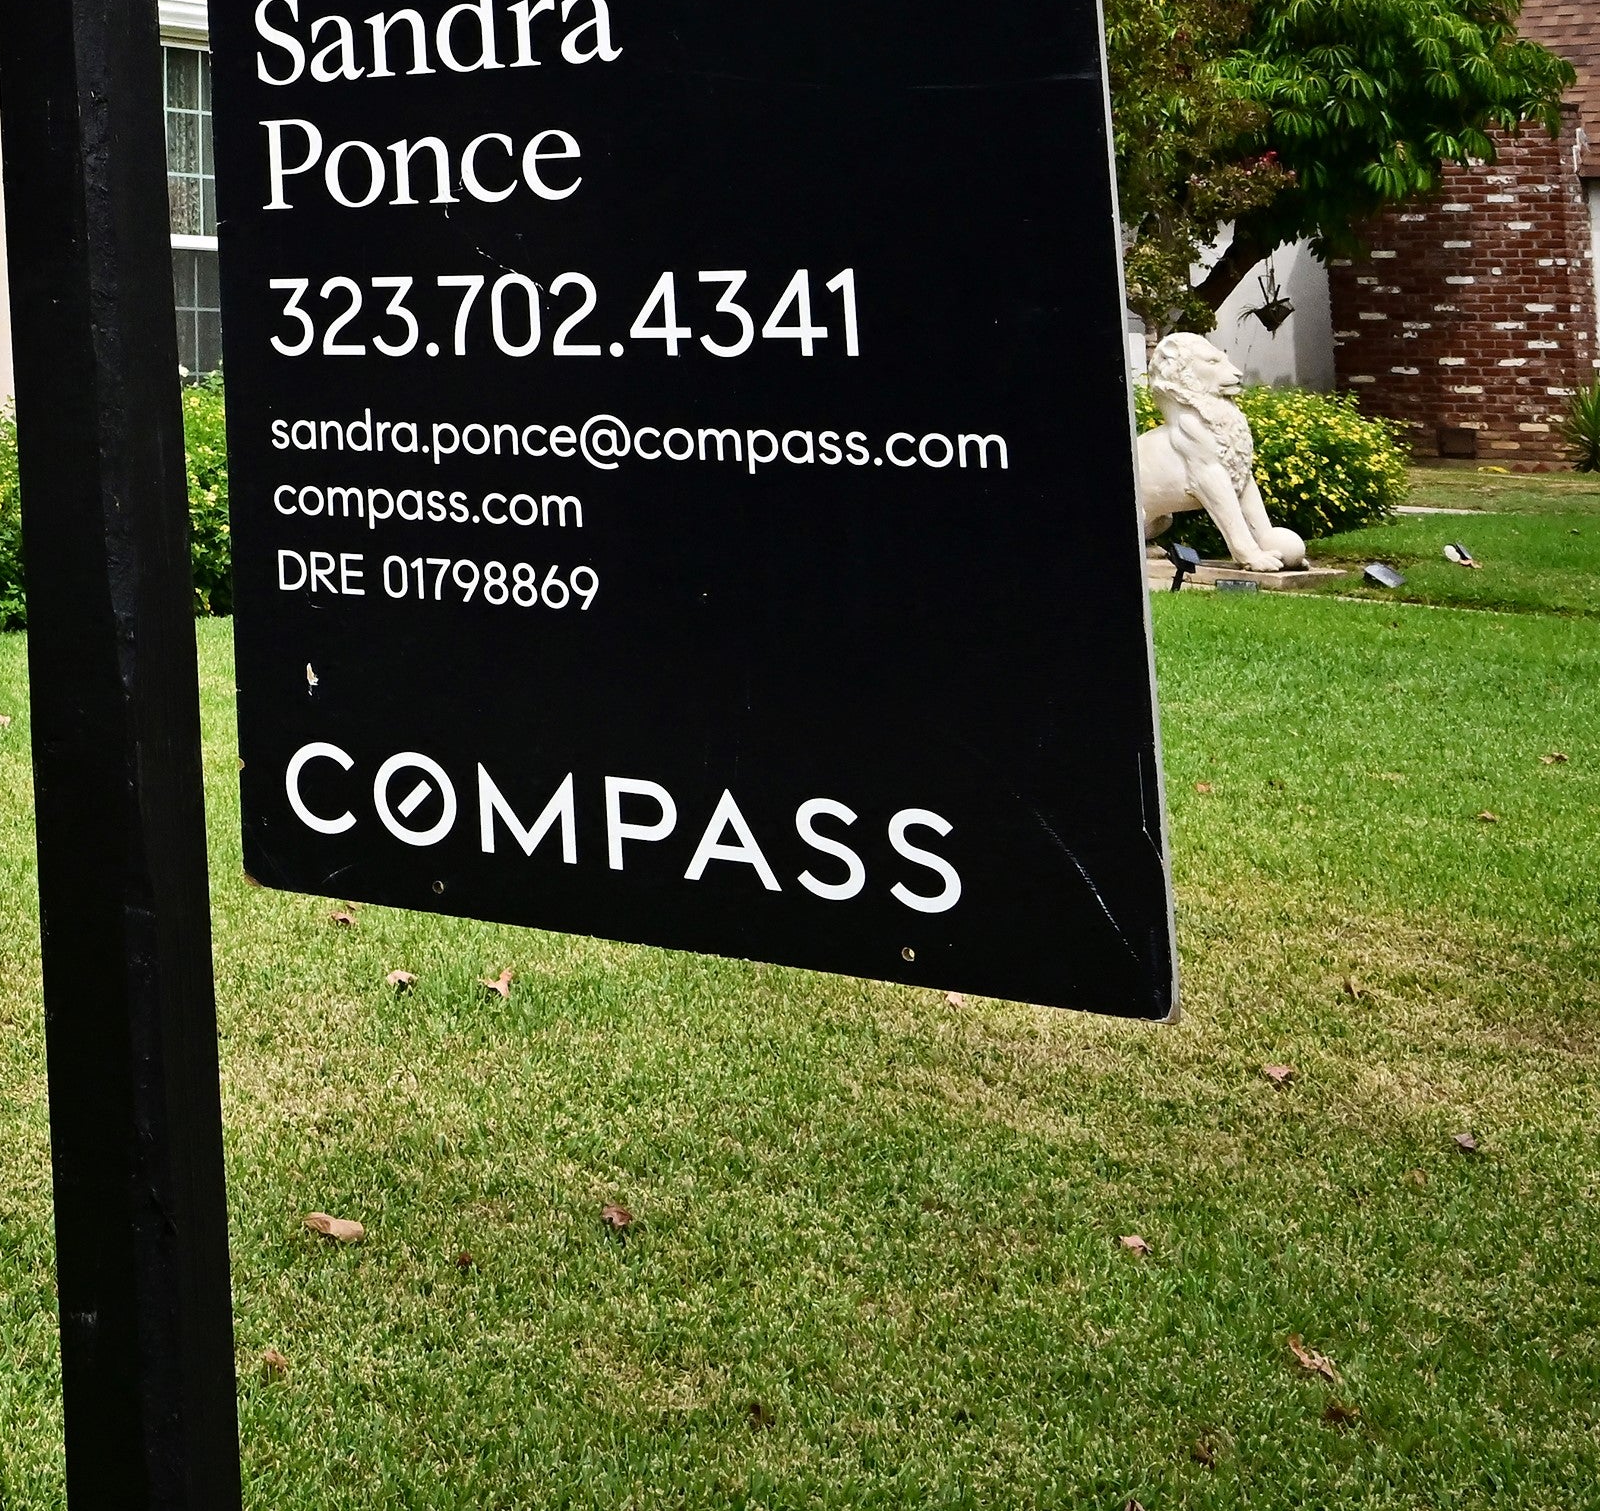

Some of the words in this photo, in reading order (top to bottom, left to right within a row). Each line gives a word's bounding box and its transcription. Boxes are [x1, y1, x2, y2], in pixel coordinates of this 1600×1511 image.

[259, 119, 582, 209] Ponce
[270, 268, 859, 357] 323.702.4341
[272, 409, 1008, 474] sandra.ponce@compass.com
[274, 485, 582, 529] compass.com
[278, 550, 365, 595] DRE
[384, 556, 599, 610] 01798869
[286, 742, 962, 913] COMPASS
